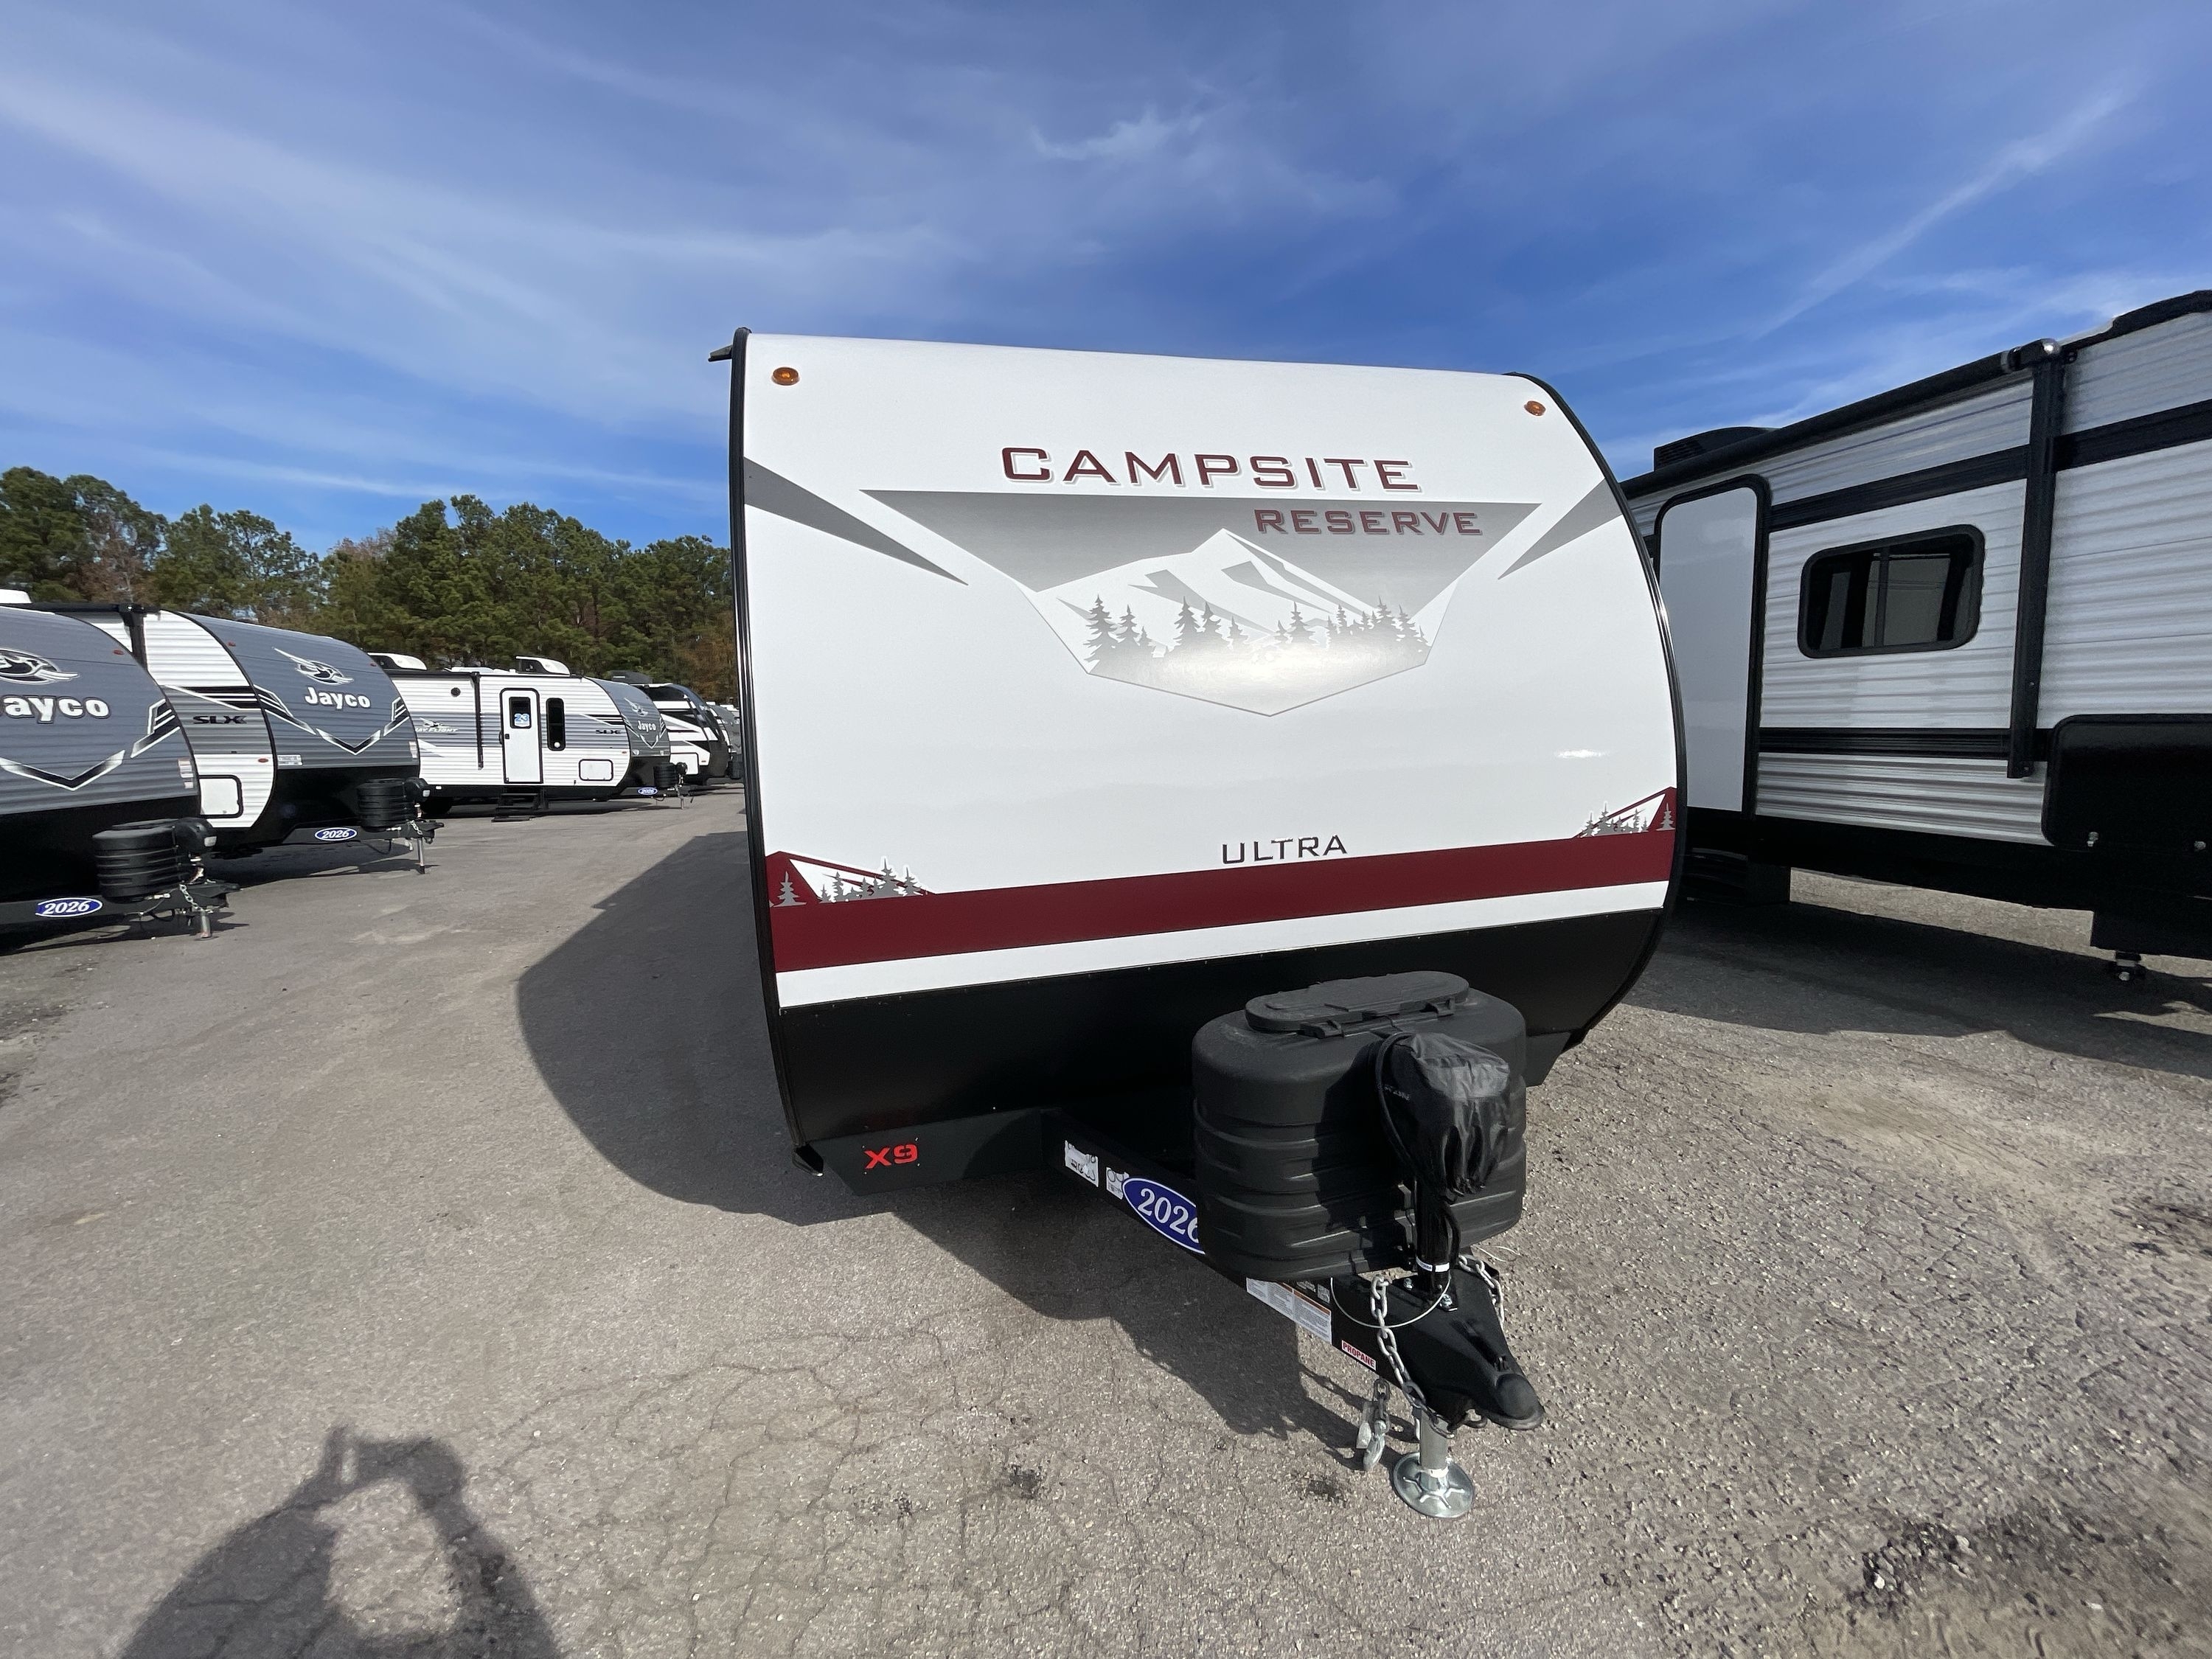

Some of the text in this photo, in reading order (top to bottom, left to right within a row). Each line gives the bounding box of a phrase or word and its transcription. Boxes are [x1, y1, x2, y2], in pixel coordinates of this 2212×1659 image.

[1001, 446, 1421, 492] CAMPSITE
[1254, 508, 1482, 535] RESERVE
[1, 695, 111, 723] ayco
[305, 686, 372, 710] Jayco
[193, 715, 247, 724] SLX
[637, 720, 656, 733] Jayco
[322, 829, 350, 839] 2026
[1222, 835, 1348, 864] ULTRA
[43, 900, 92, 915] 2026
[864, 1144, 918, 1169] X9
[1343, 1341, 1375, 1368] PROPANE
